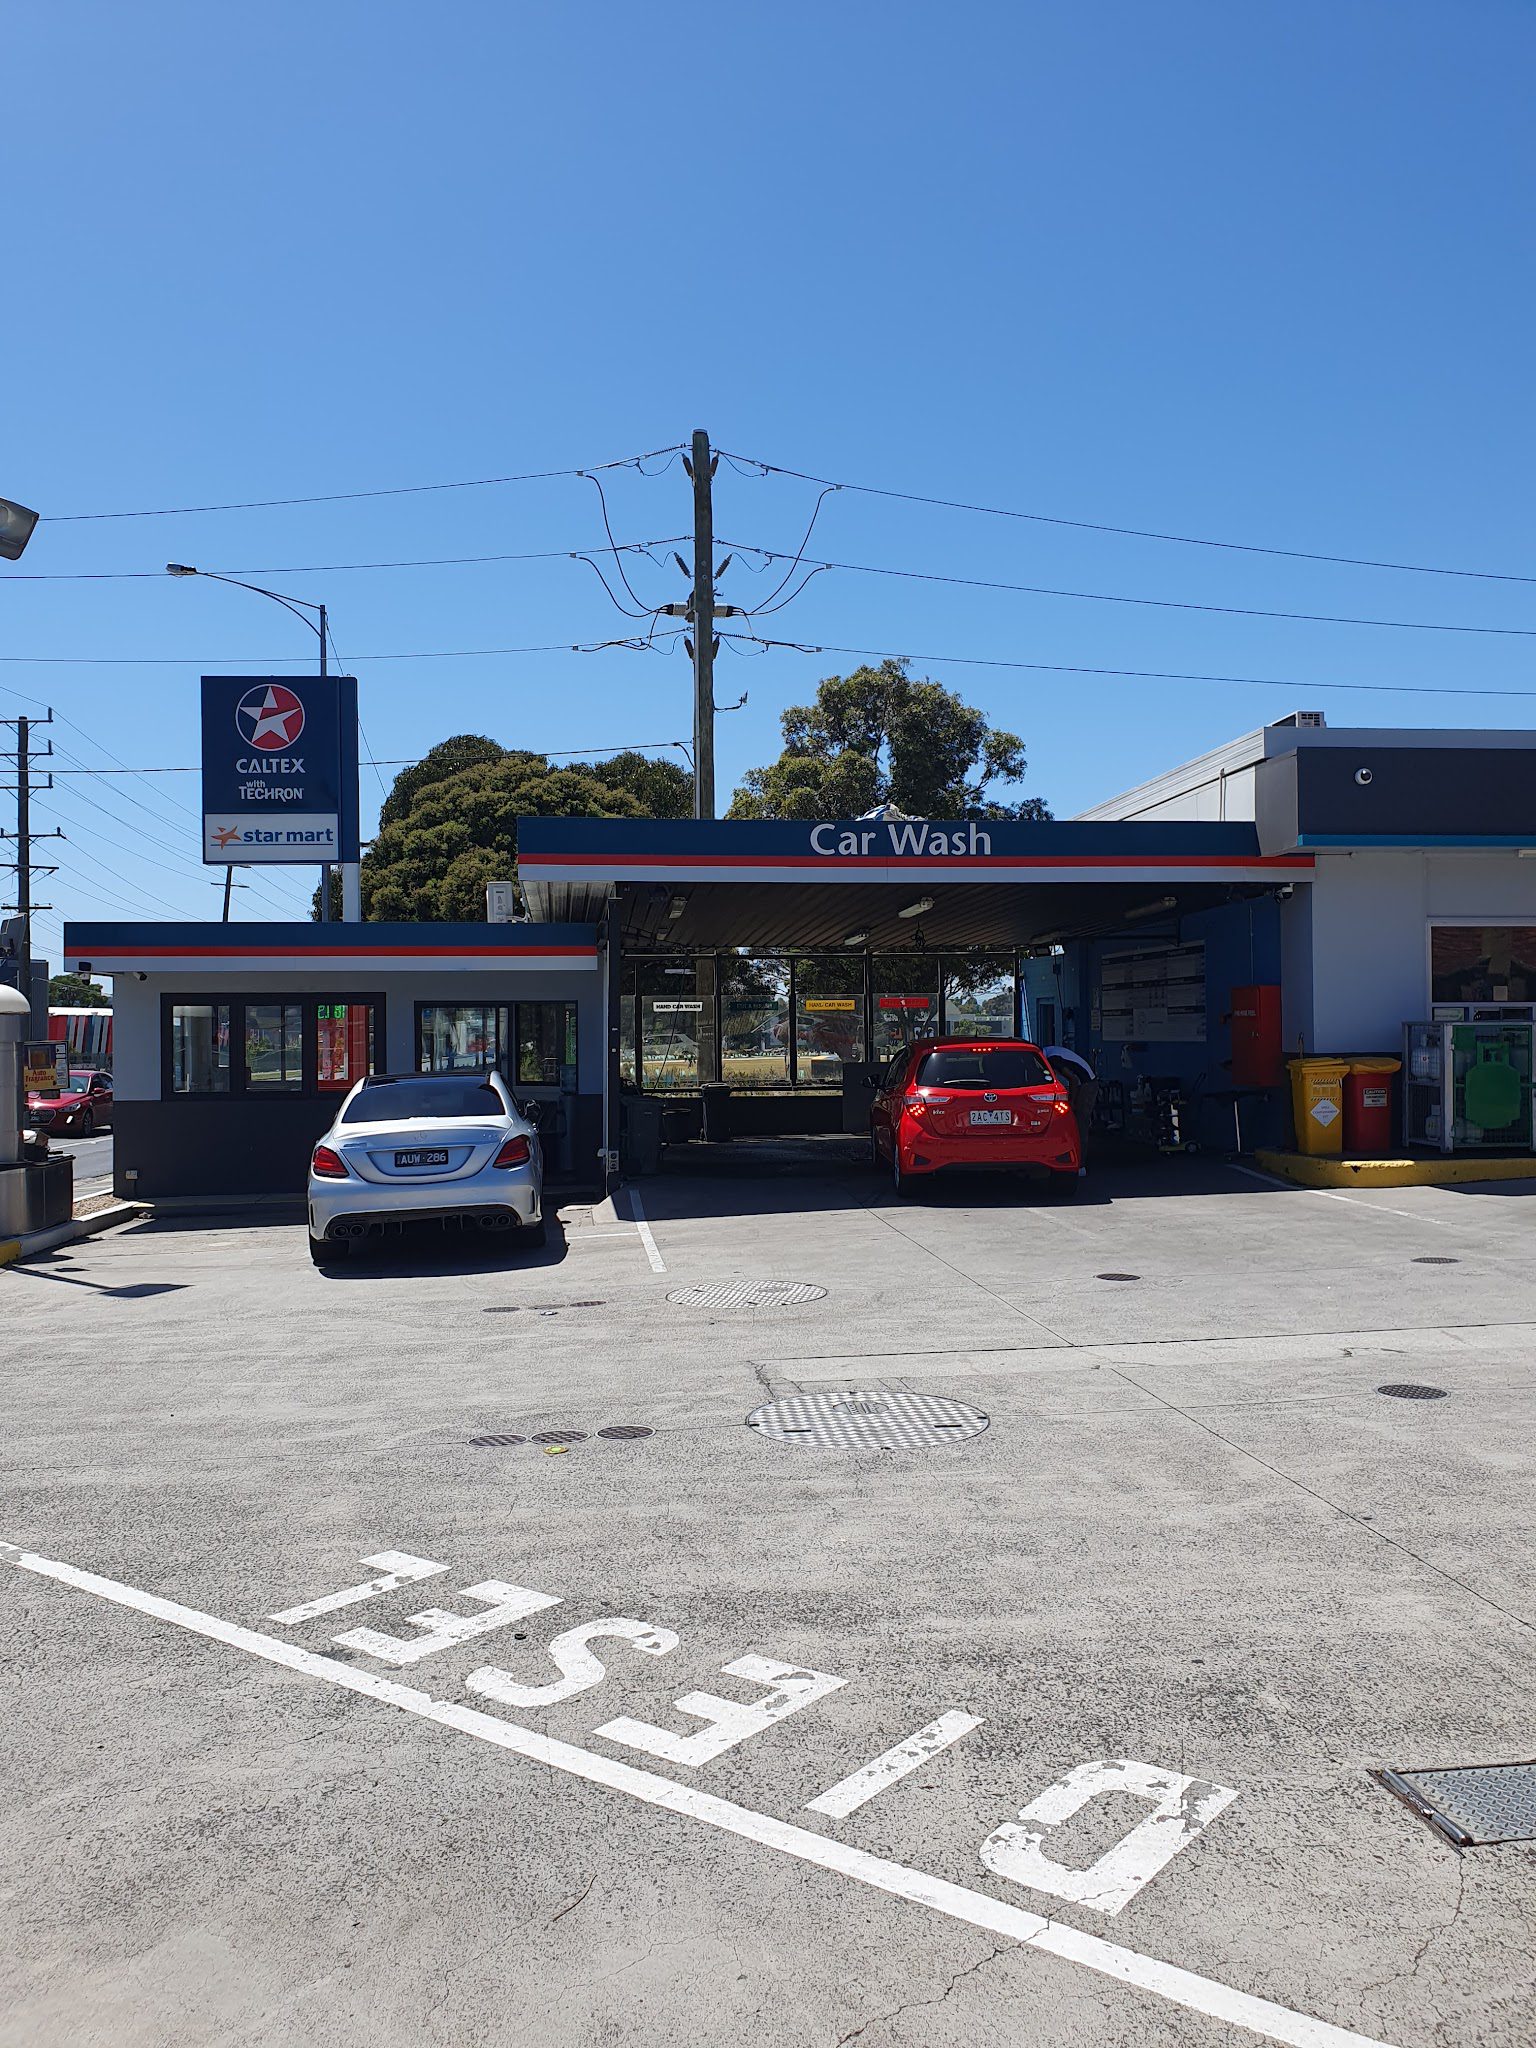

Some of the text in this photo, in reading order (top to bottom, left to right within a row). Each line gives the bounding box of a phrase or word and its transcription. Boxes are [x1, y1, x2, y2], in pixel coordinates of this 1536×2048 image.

[235, 758, 306, 774] CALTEX
[246, 779, 266, 788] with
[238, 786, 304, 802] TECHRON
[243, 828, 334, 843] star mart
[809, 822, 992, 856] Car Wash
[972, 1112, 988, 1122] 2AC
[267, 1549, 1240, 1918] DIESEL
